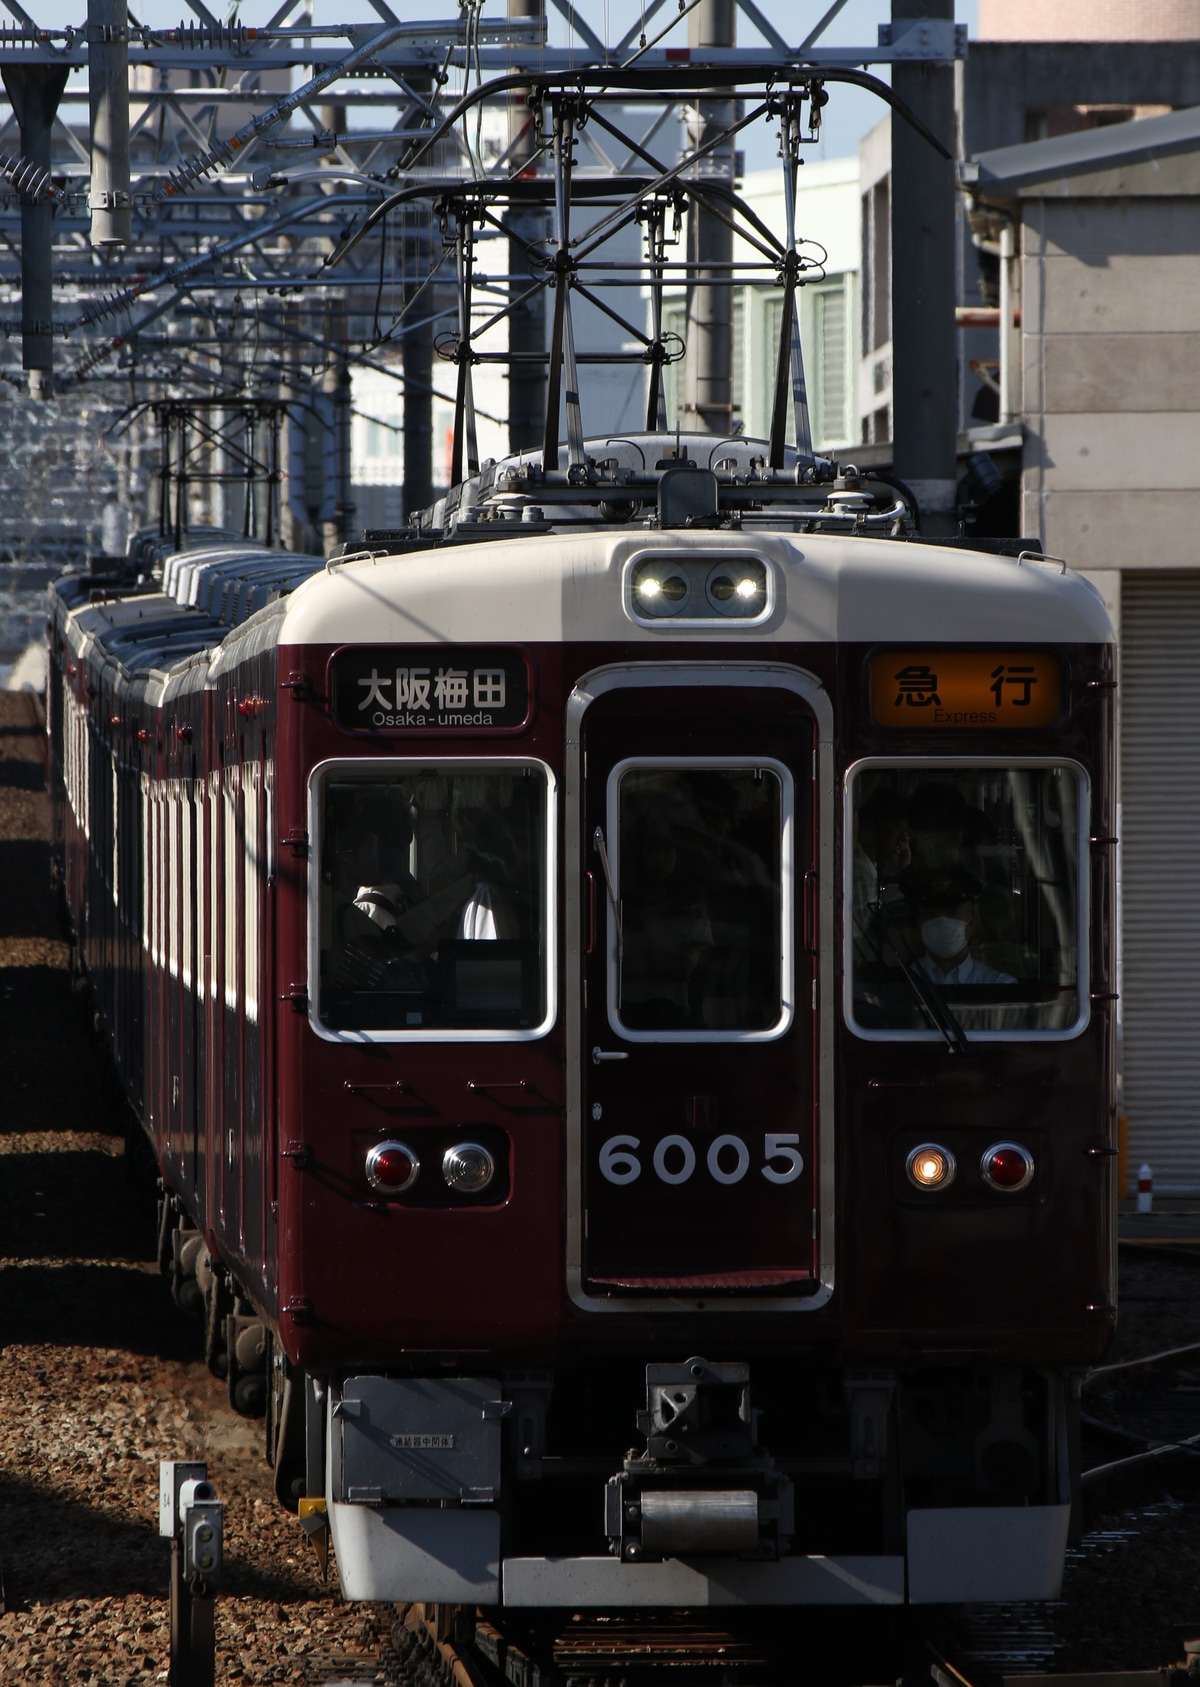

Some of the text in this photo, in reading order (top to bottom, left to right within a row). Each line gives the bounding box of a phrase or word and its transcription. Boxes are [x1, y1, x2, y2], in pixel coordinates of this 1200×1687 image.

[357, 667, 506, 711] 大阪梅田
[894, 665, 1038, 707] 急行
[372, 711, 493, 726] Osaka-umeda
[934, 709, 997, 725] Express
[598, 1133, 804, 1185] 6005
